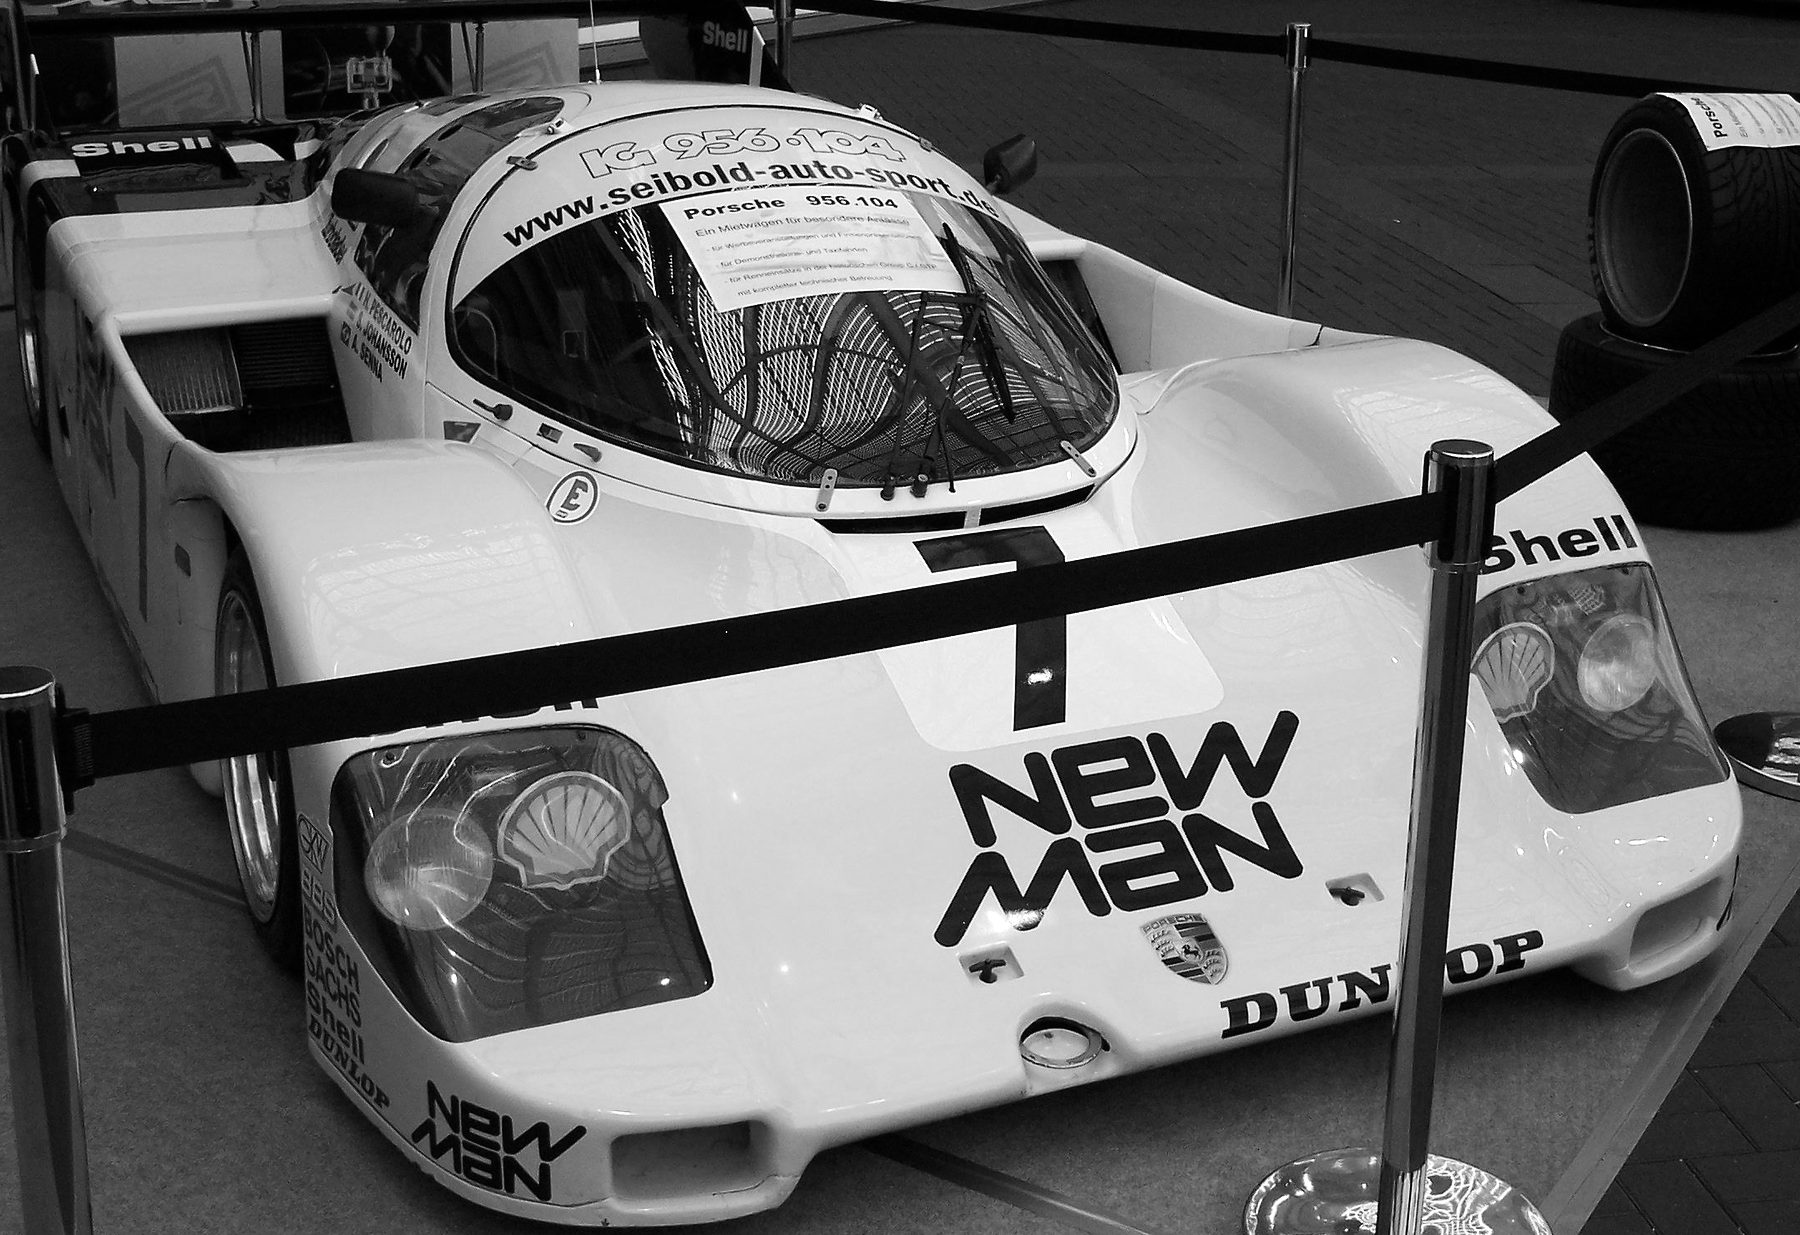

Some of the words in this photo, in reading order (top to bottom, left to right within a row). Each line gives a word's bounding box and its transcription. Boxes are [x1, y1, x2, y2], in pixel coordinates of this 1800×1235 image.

[703, 20, 748, 53] Shell
[72, 136, 212, 157] Shell
[502, 160, 998, 248] www.seibold-auto-sport.de
[684, 198, 785, 220] Porsche
[805, 195, 899, 209] 956.104
[695, 227, 716, 238] Ein
[717, 217, 784, 235] Mietwagen
[786, 216, 802, 226] für
[803, 214, 864, 224] besondere
[363, 319, 408, 380] JOHANSSON
[369, 299, 412, 355] PESCAROLO
[360, 342, 383, 383] SENNA
[1481, 515, 1639, 575] Shell
[303, 904, 361, 995] BOSCH
[305, 943, 362, 1028] SACHS
[1220, 928, 1545, 1039] DUNOP
[306, 981, 365, 1065] Shell
[308, 1014, 391, 1109] DUNLOP
